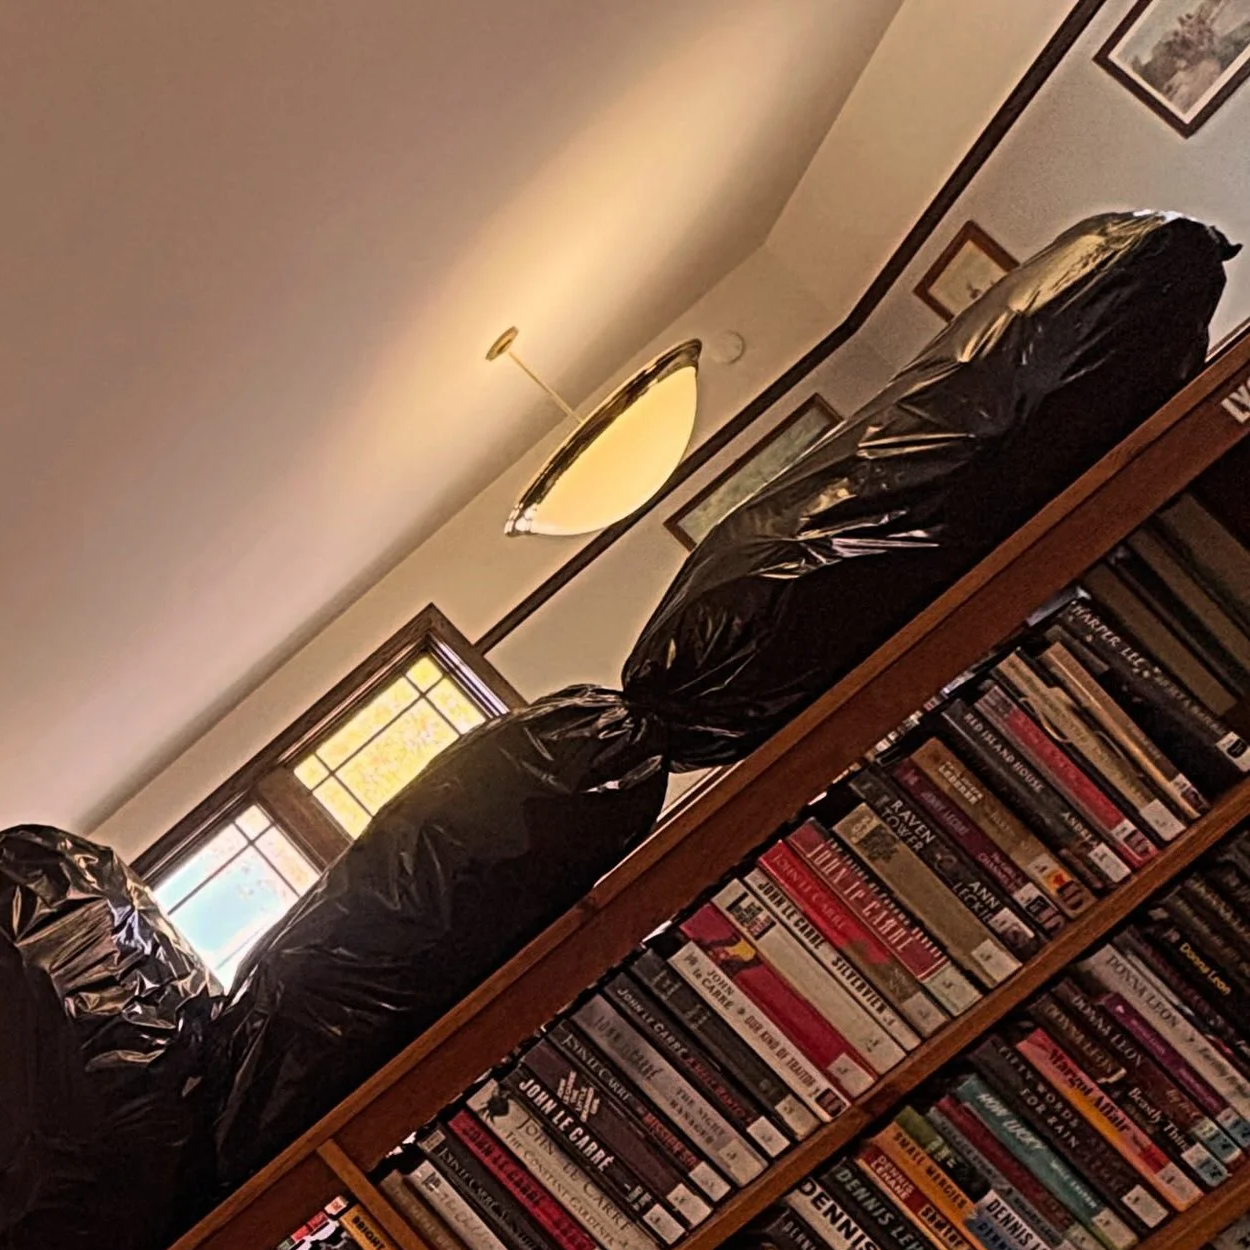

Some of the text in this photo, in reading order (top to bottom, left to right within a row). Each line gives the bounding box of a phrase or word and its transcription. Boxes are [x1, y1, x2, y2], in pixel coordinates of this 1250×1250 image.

[962, 711, 1044, 793] RED ISLAND HOUSE
[890, 799, 936, 844] RAVEN
[968, 878, 999, 909] ANN
[706, 967, 735, 997] JOHN
[1105, 952, 1182, 1028] DONNA LEON
[1178, 941, 1233, 996] Donna Leon
[759, 1029, 780, 1050] KIND
[1070, 992, 1147, 1067] DONNA LEON
[998, 1043, 1080, 1129] FIFTY WORDS
[1018, 1085, 1081, 1148] FOR RAIN
[1126, 1085, 1167, 1124] Beastly
[516, 1075, 617, 1172] JOHN LE CARRÉ
[975, 1089, 1045, 1155] HOW LUCKY
[833, 1166, 897, 1227] DENNIS
[876, 1153, 917, 1195] DENNIS
[892, 1130, 968, 1210] SMALL MERCIES
[985, 1196, 1035, 1247] DENNIS
